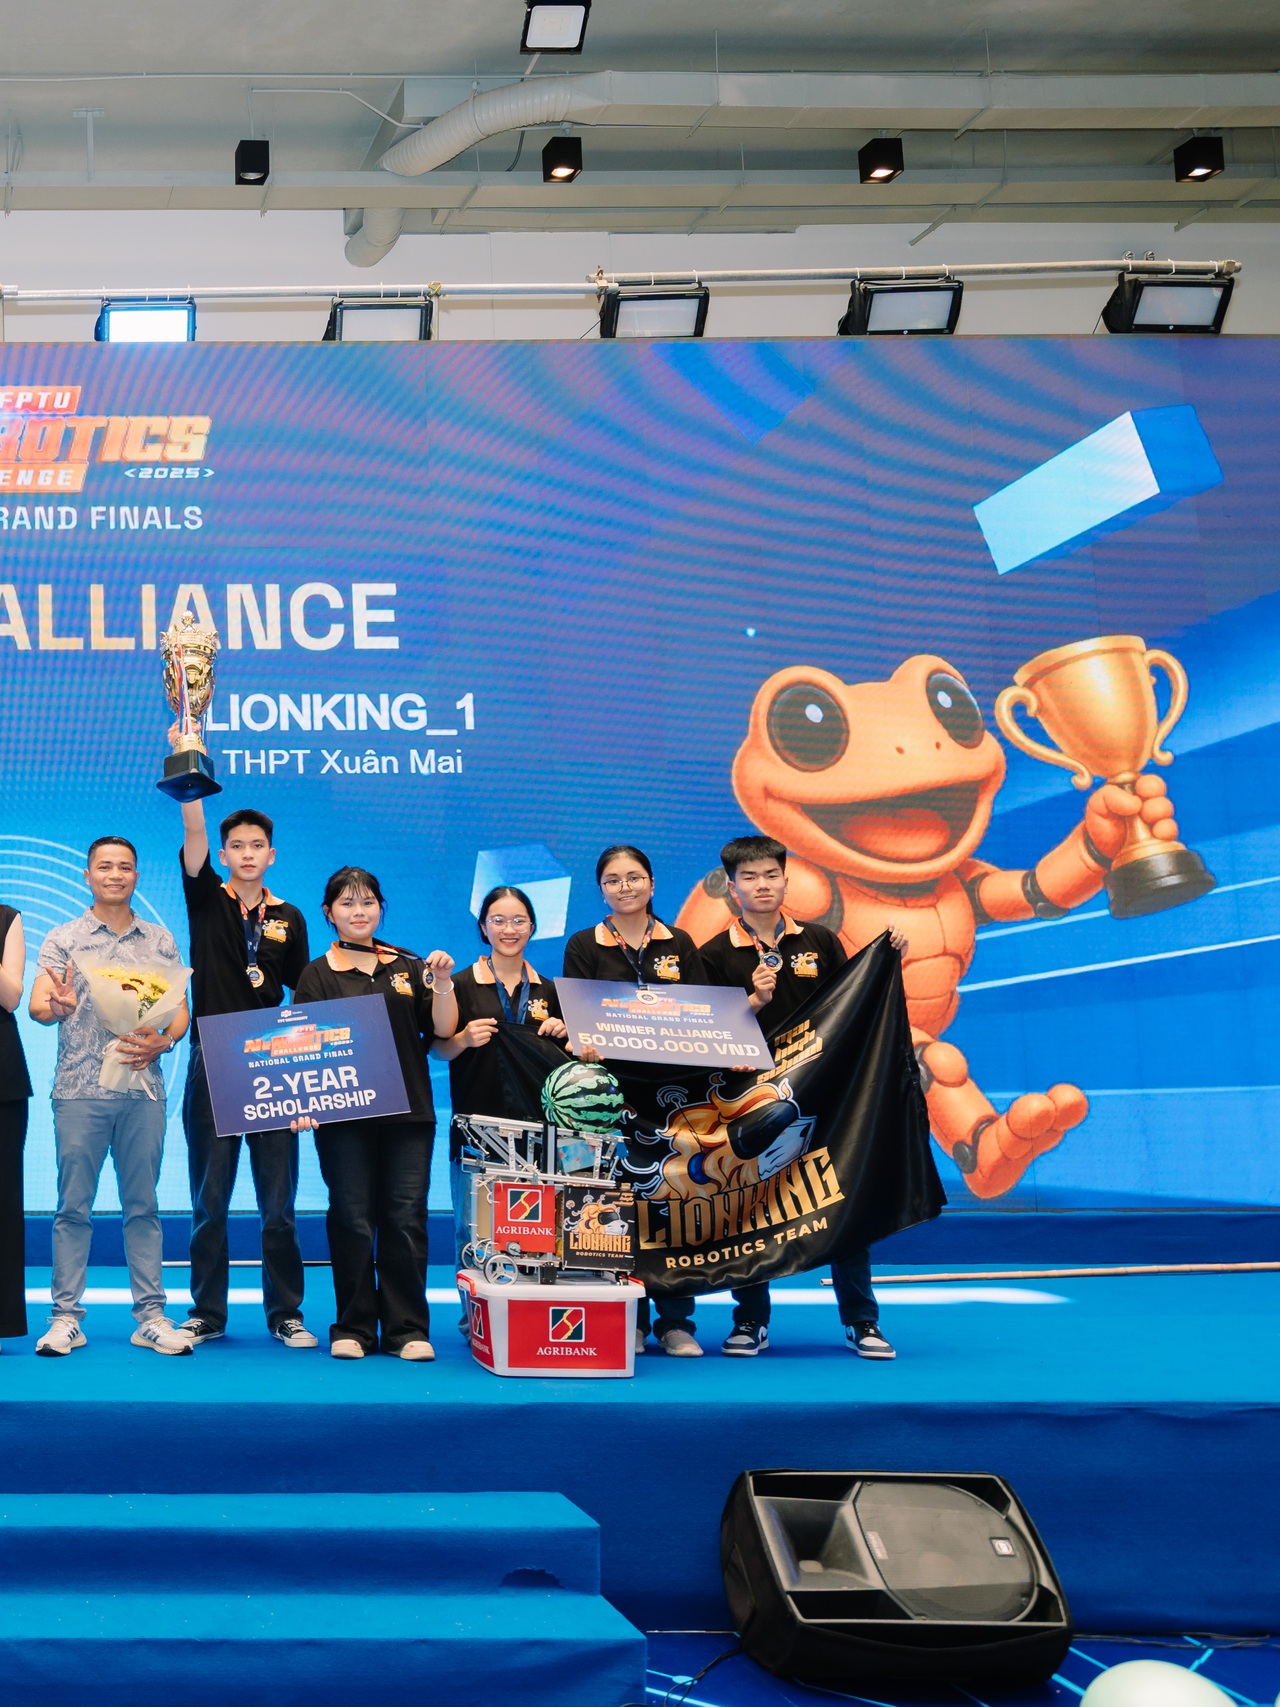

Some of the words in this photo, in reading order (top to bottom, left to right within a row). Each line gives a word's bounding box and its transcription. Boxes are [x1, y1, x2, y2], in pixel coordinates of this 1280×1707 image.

[91, 506, 203, 530] FINALS
[206, 692, 475, 736] LIONKING_1
[222, 750, 310, 774] THPT
[320, 750, 399, 774] Xuân
[411, 750, 463, 774] Mai
[606, 1012, 648, 1020] NATIONAL
[596, 1022, 655, 1036] WINNER
[660, 1027, 733, 1040] ALLIANCE
[578, 1032, 709, 1054] 50.000.000
[713, 1043, 761, 1057] VND
[248, 1058, 290, 1068] NATIONAL
[292, 1054, 321, 1062] GRAND
[324, 1049, 354, 1059] FINALS
[253, 1065, 359, 1100] 2-YEAR
[244, 1089, 377, 1121] SCHOLARSHIP
[635, 1146, 845, 1250] LIONKING
[495, 1225, 553, 1236] AGRIBANK
[569, 1232, 631, 1253] LIONKING
[666, 1239, 766, 1269] ROBOTICS
[774, 1216, 828, 1245] TEAM
[536, 1346, 597, 1356] AGRIBANK
